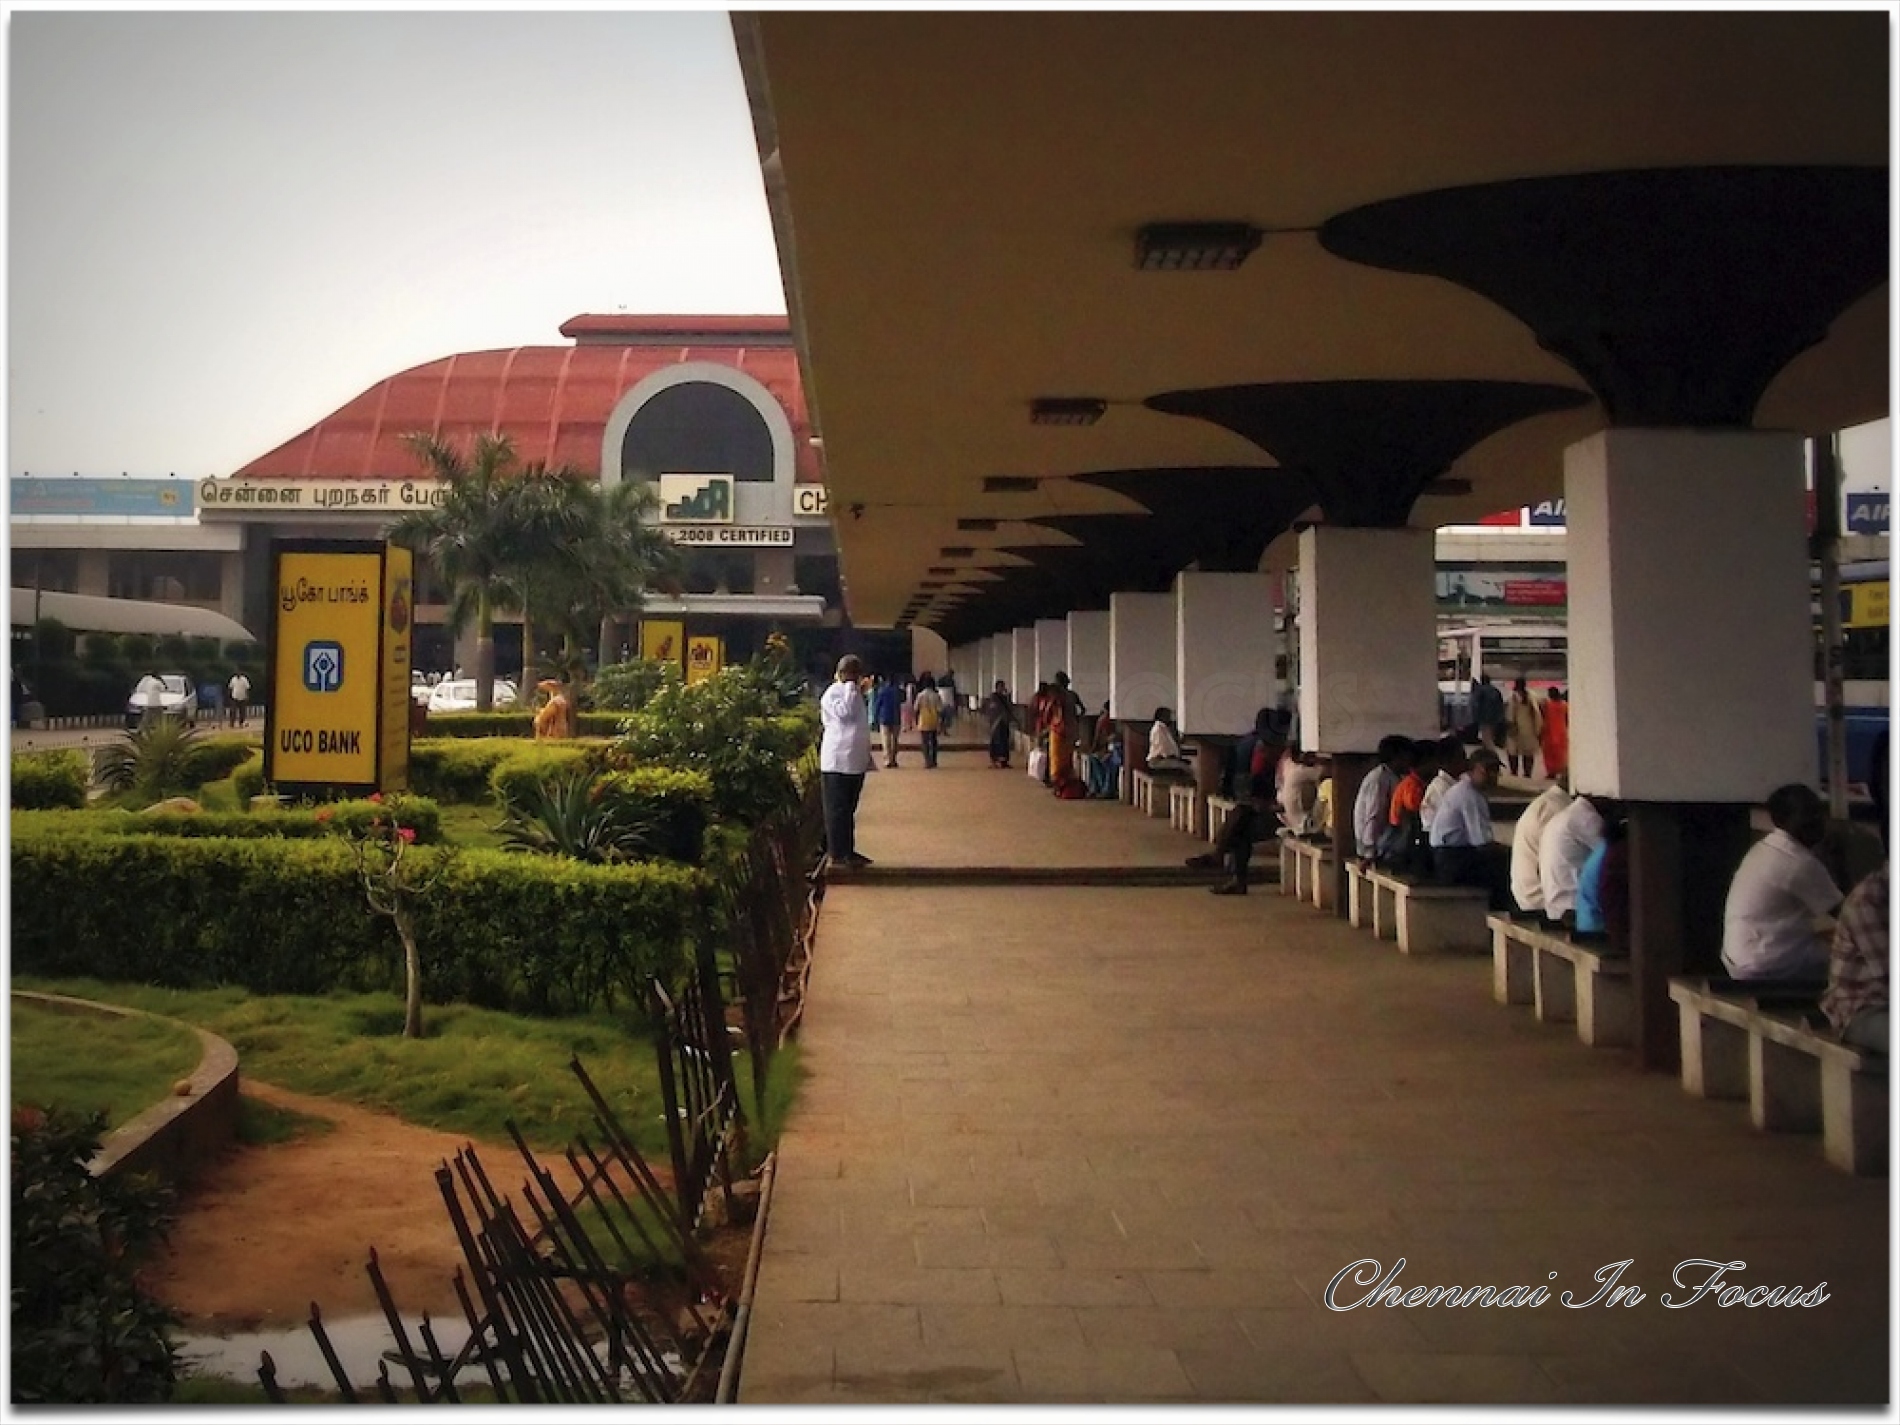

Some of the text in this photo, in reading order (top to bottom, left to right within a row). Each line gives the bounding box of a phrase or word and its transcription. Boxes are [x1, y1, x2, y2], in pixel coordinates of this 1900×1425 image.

[201, 481, 303, 503] சென்னை
[313, 483, 391, 508] புறநகர்
[679, 530, 714, 541] 2008
[719, 530, 791, 542] CERTIFIED
[281, 577, 323, 611] யூகோ
[280, 729, 361, 754] UCO BANK
